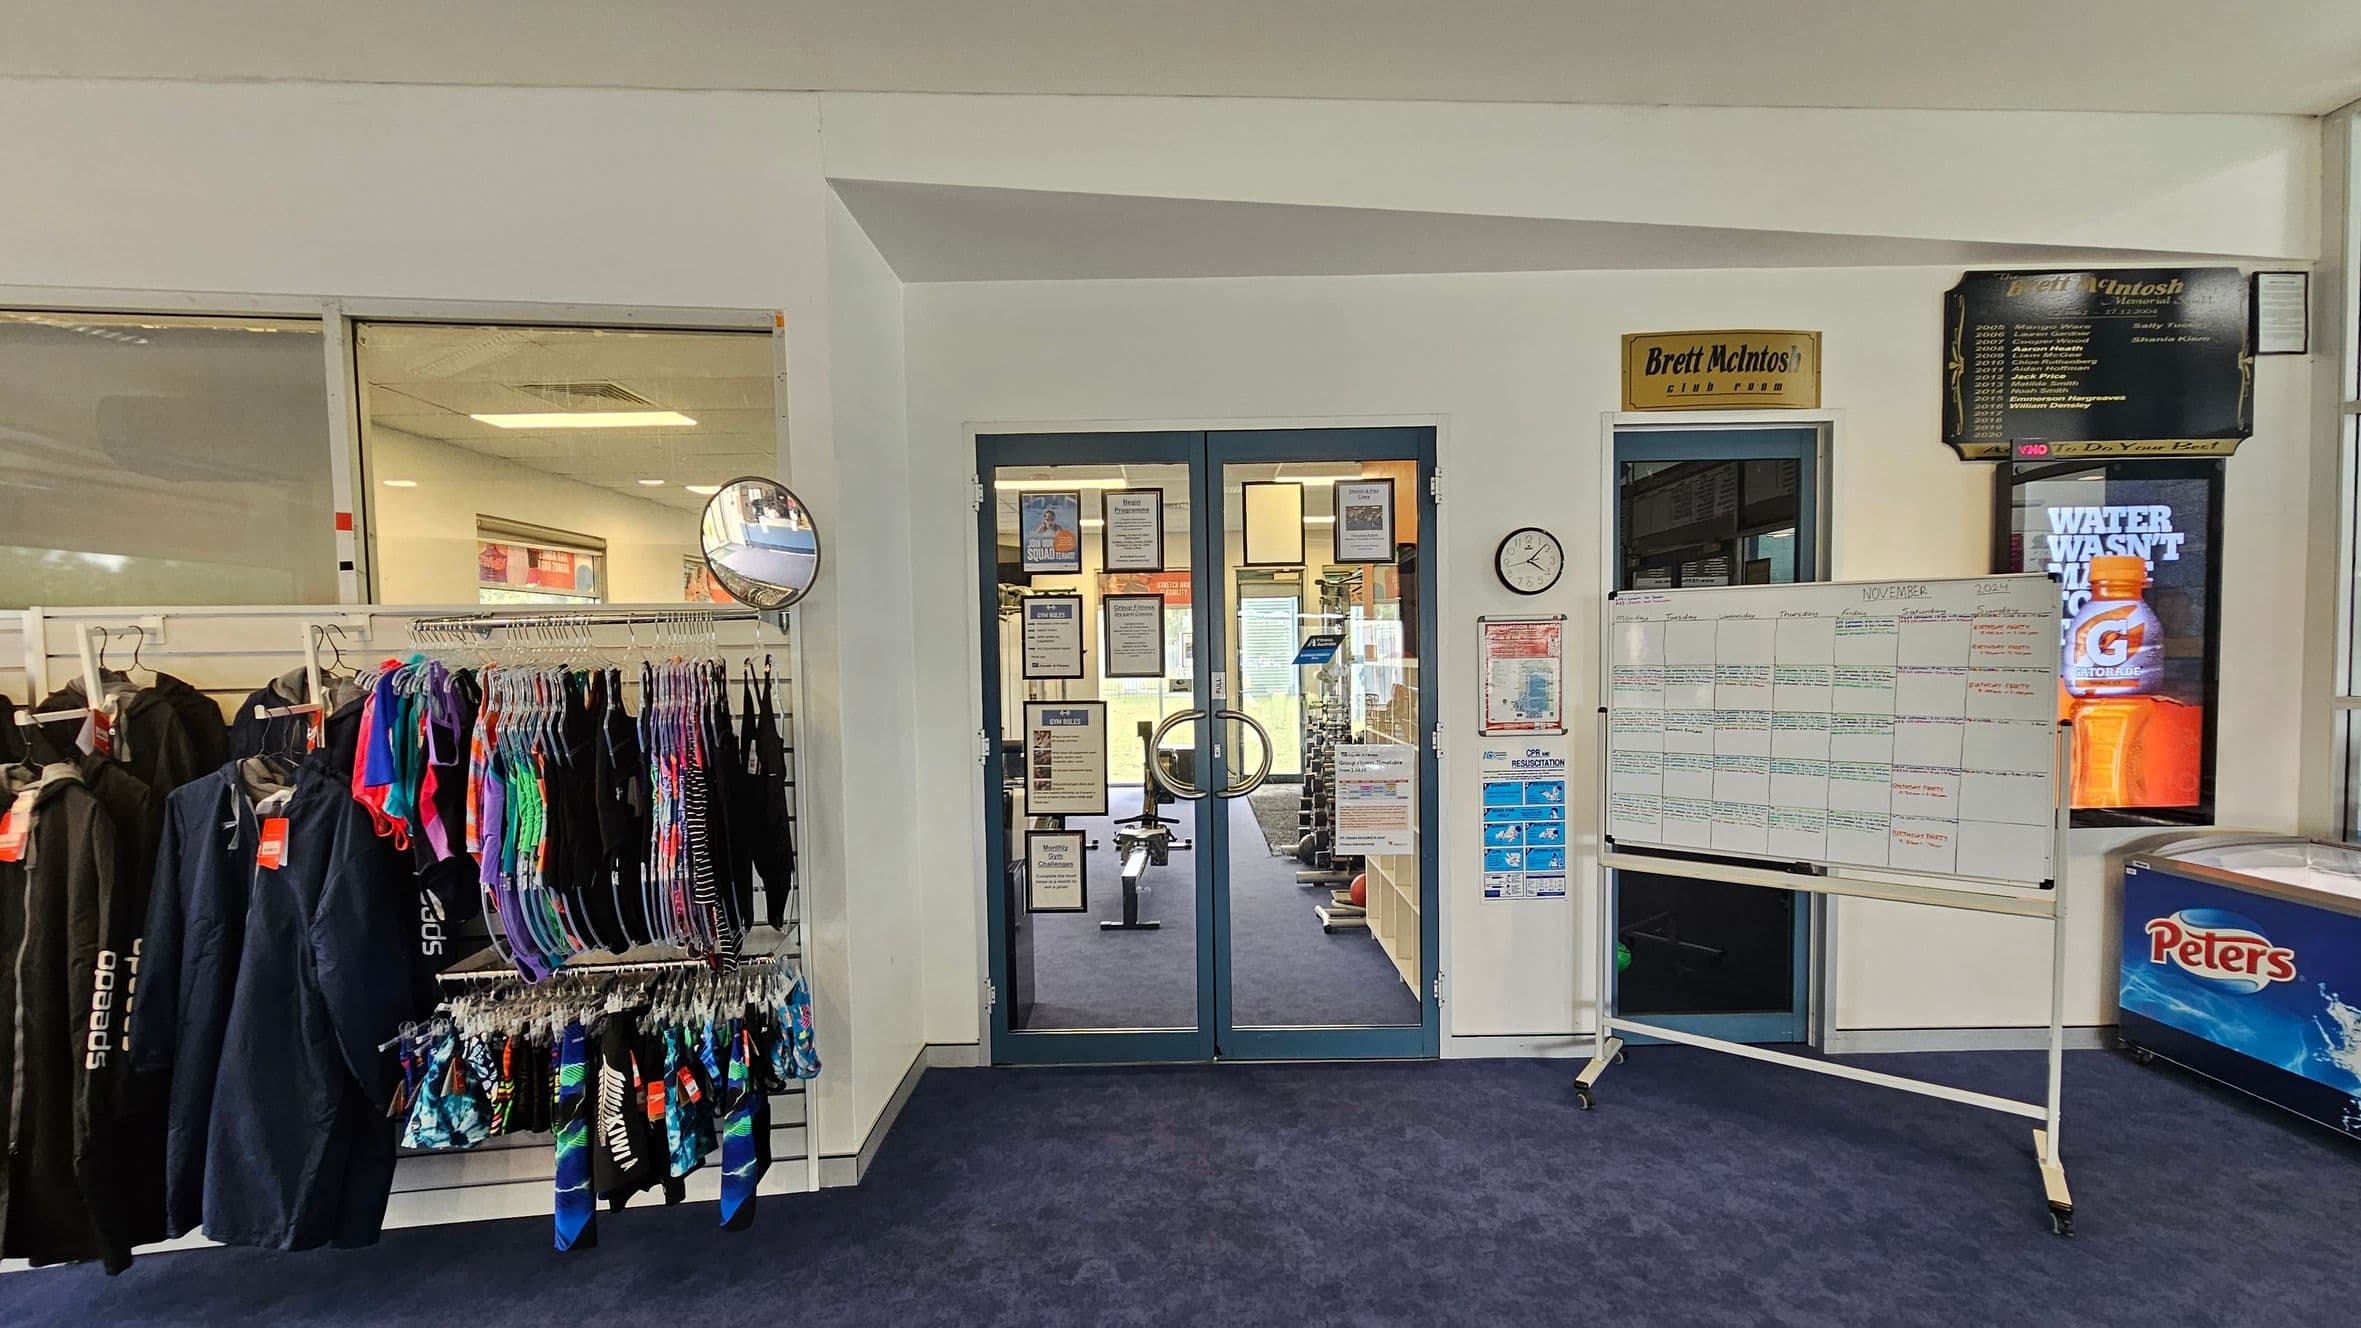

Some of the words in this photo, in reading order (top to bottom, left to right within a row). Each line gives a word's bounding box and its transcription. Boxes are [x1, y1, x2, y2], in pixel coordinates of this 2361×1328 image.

[2132, 322, 2164, 330] Sally
[2012, 338, 2054, 346] Cooper
[2131, 336, 2176, 344] Shania
[1645, 346, 1704, 376] Brett
[1707, 344, 1802, 373] McIntosh
[1667, 382, 1714, 393] club
[1734, 381, 1783, 391] room
[2068, 394, 2126, 403] Hargreaves
[2050, 402, 2092, 410] Densley
[2083, 442, 2113, 452] Do
[2120, 442, 2163, 452] Your
[2173, 441, 2219, 451] Best
[2047, 505, 2173, 534] WATER
[2047, 532, 2185, 562] WASN'T
[1027, 547, 1055, 561] SQUAD
[1862, 585, 1929, 600] NOVEMBER
[1975, 584, 2009, 594] 2024
[1777, 610, 1819, 618] Thursday
[1841, 607, 1867, 617] Friday
[1902, 607, 1947, 615] Saturday
[1976, 605, 2019, 615] Sunday
[2086, 619, 2128, 667] G
[2074, 667, 2142, 678] GATORADE
[1526, 749, 1540, 757] CPR
[1512, 759, 1565, 767] RESUSCITATION
[2147, 919, 2293, 980] Peters
[86, 951, 116, 1070] speedo
[607, 1113, 632, 1169] KIWI
